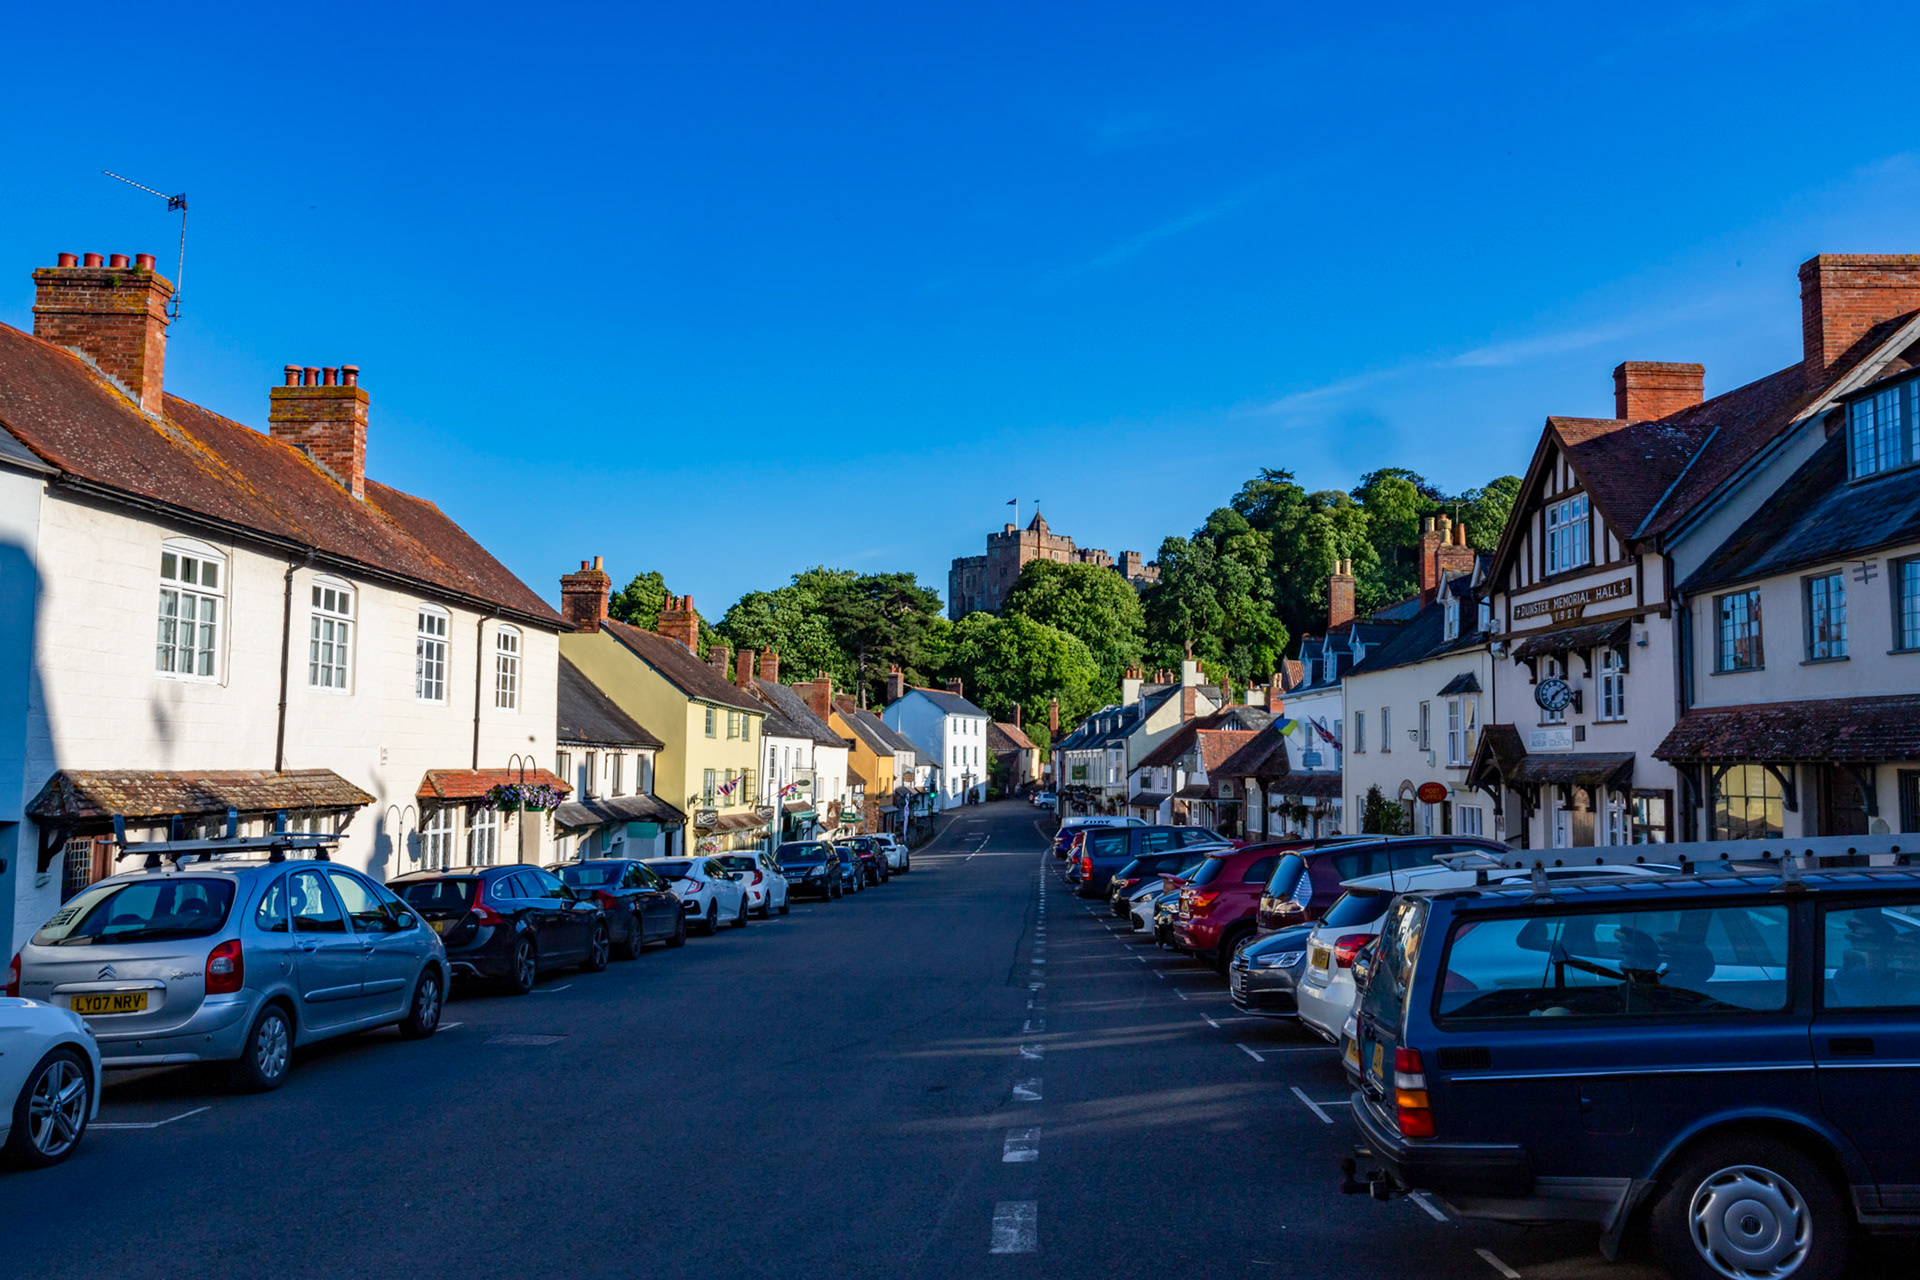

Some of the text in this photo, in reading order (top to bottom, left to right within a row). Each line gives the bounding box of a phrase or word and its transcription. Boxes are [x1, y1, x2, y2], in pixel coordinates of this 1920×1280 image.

[1521, 584, 1618, 616] DUNSTER MEMORIAL HALL
[1555, 607, 1577, 620] 1921
[76, 993, 142, 1011] LY07 NRV
